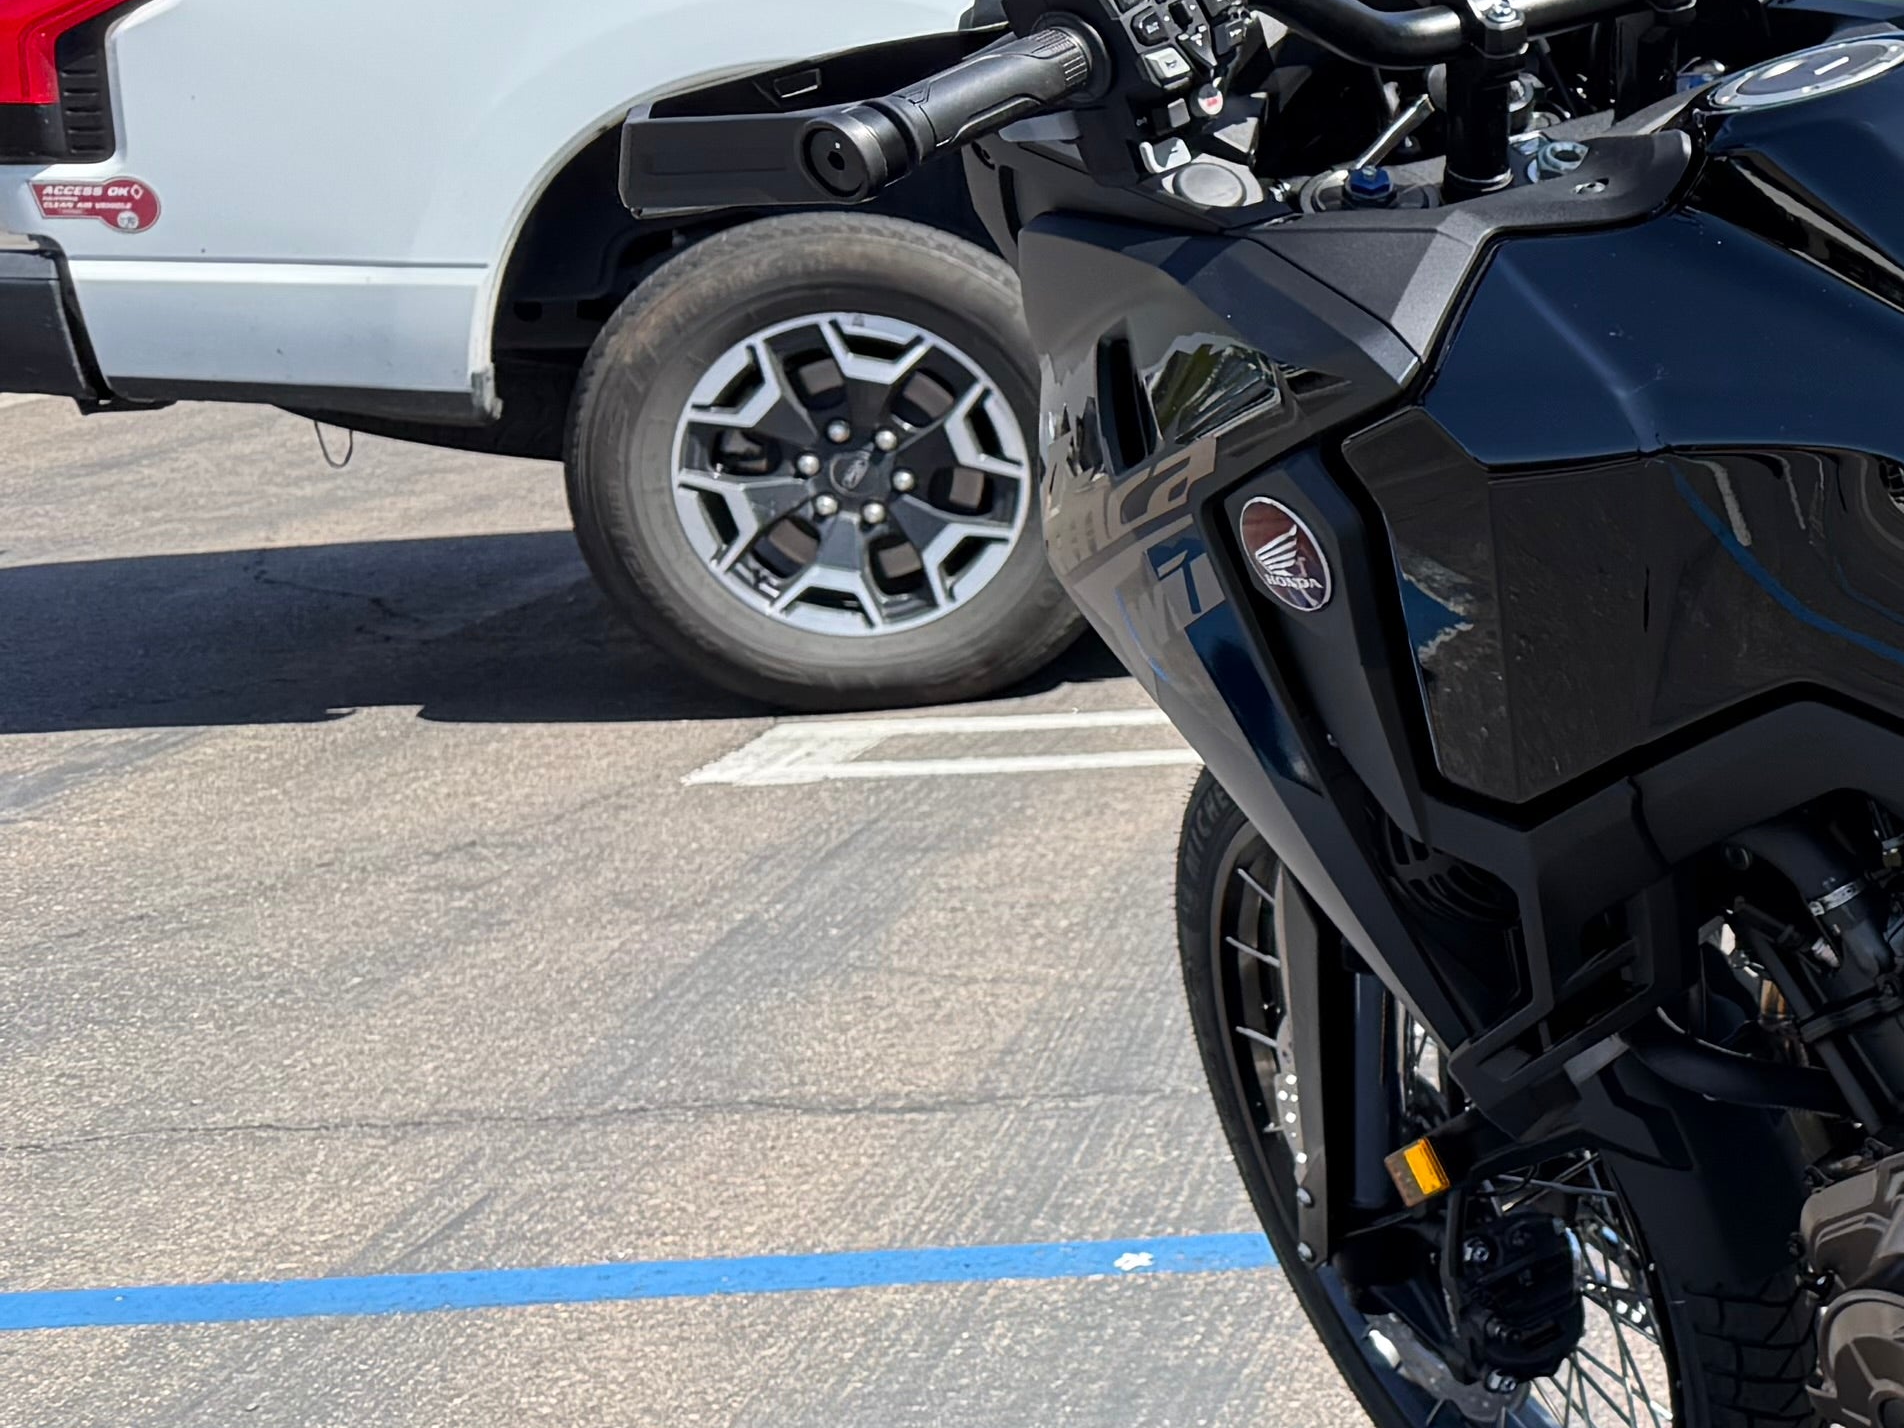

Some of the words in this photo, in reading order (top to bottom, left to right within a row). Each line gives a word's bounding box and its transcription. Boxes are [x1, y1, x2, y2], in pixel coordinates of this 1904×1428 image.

[42, 185, 103, 197] ACCESS
[107, 186, 129, 197] OK
[1264, 573, 1324, 589] HONDA
